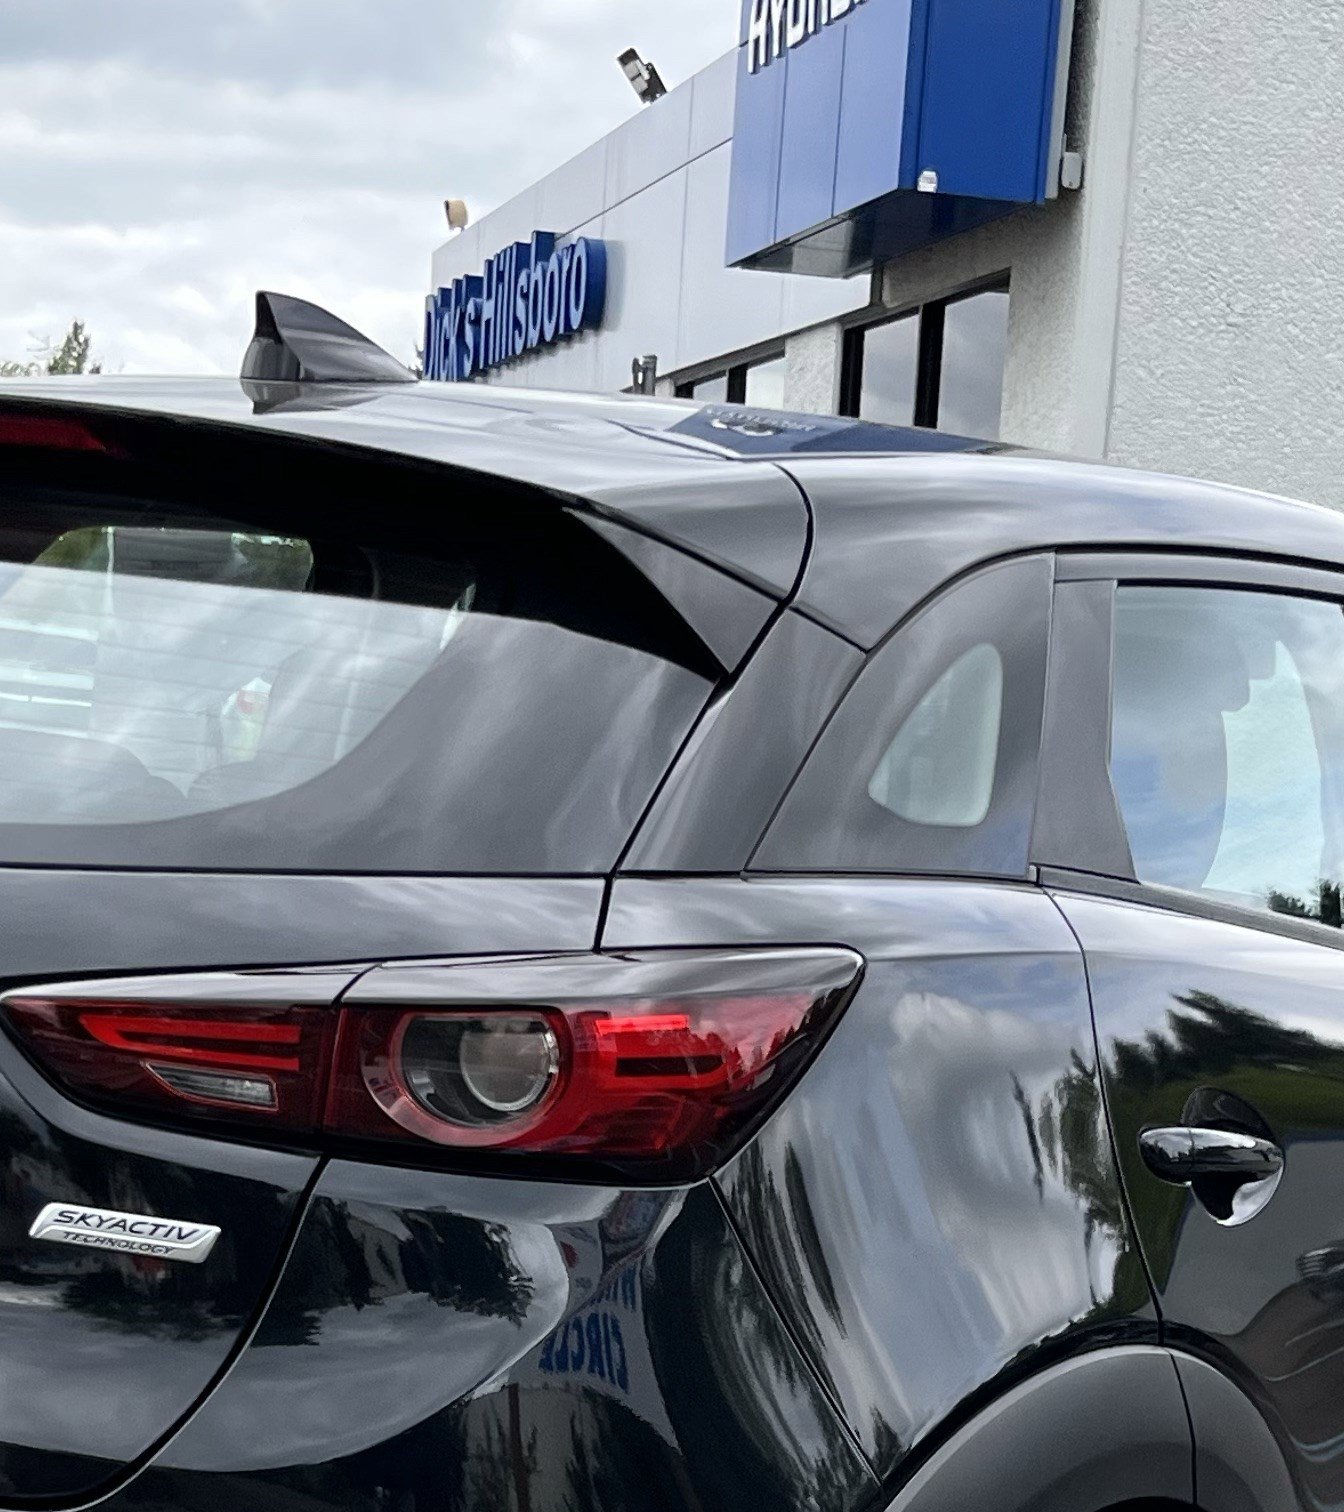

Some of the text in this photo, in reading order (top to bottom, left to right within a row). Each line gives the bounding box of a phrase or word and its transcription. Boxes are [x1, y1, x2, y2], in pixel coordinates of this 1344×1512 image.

[423, 232, 591, 381] Dick's Hillsboro
[53, 1209, 199, 1241] SKYACTIV
[62, 1231, 176, 1255] TECHNOLOGY
